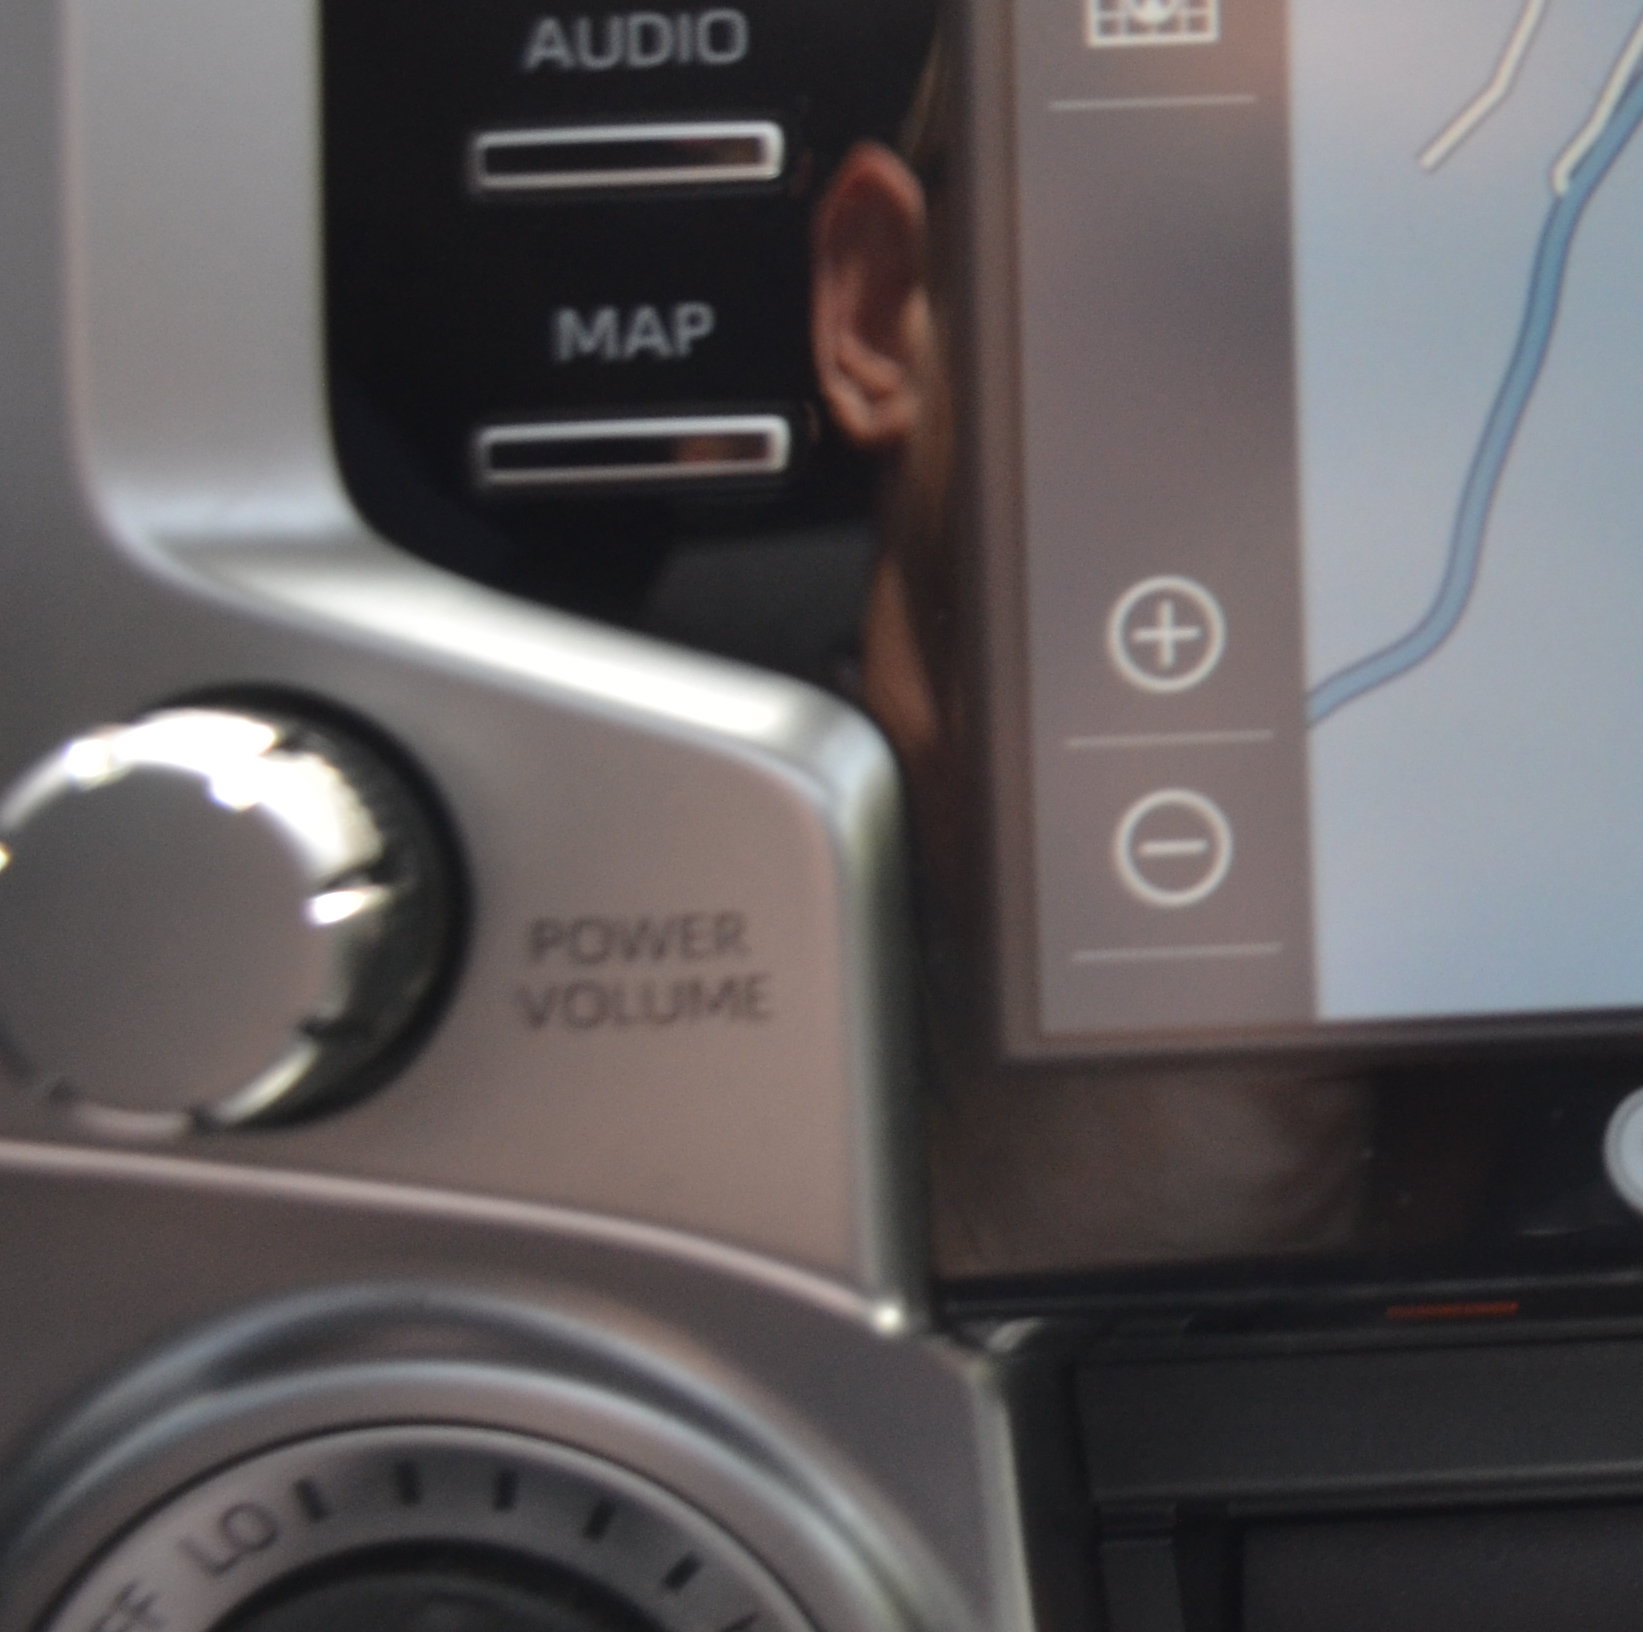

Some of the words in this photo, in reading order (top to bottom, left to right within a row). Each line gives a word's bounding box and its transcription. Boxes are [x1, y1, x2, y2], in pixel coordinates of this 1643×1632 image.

[522, 9, 751, 72] AUDIO
[553, 302, 716, 361] MAP
[529, 910, 753, 965] POWER
[515, 972, 776, 1032] VOLUME
